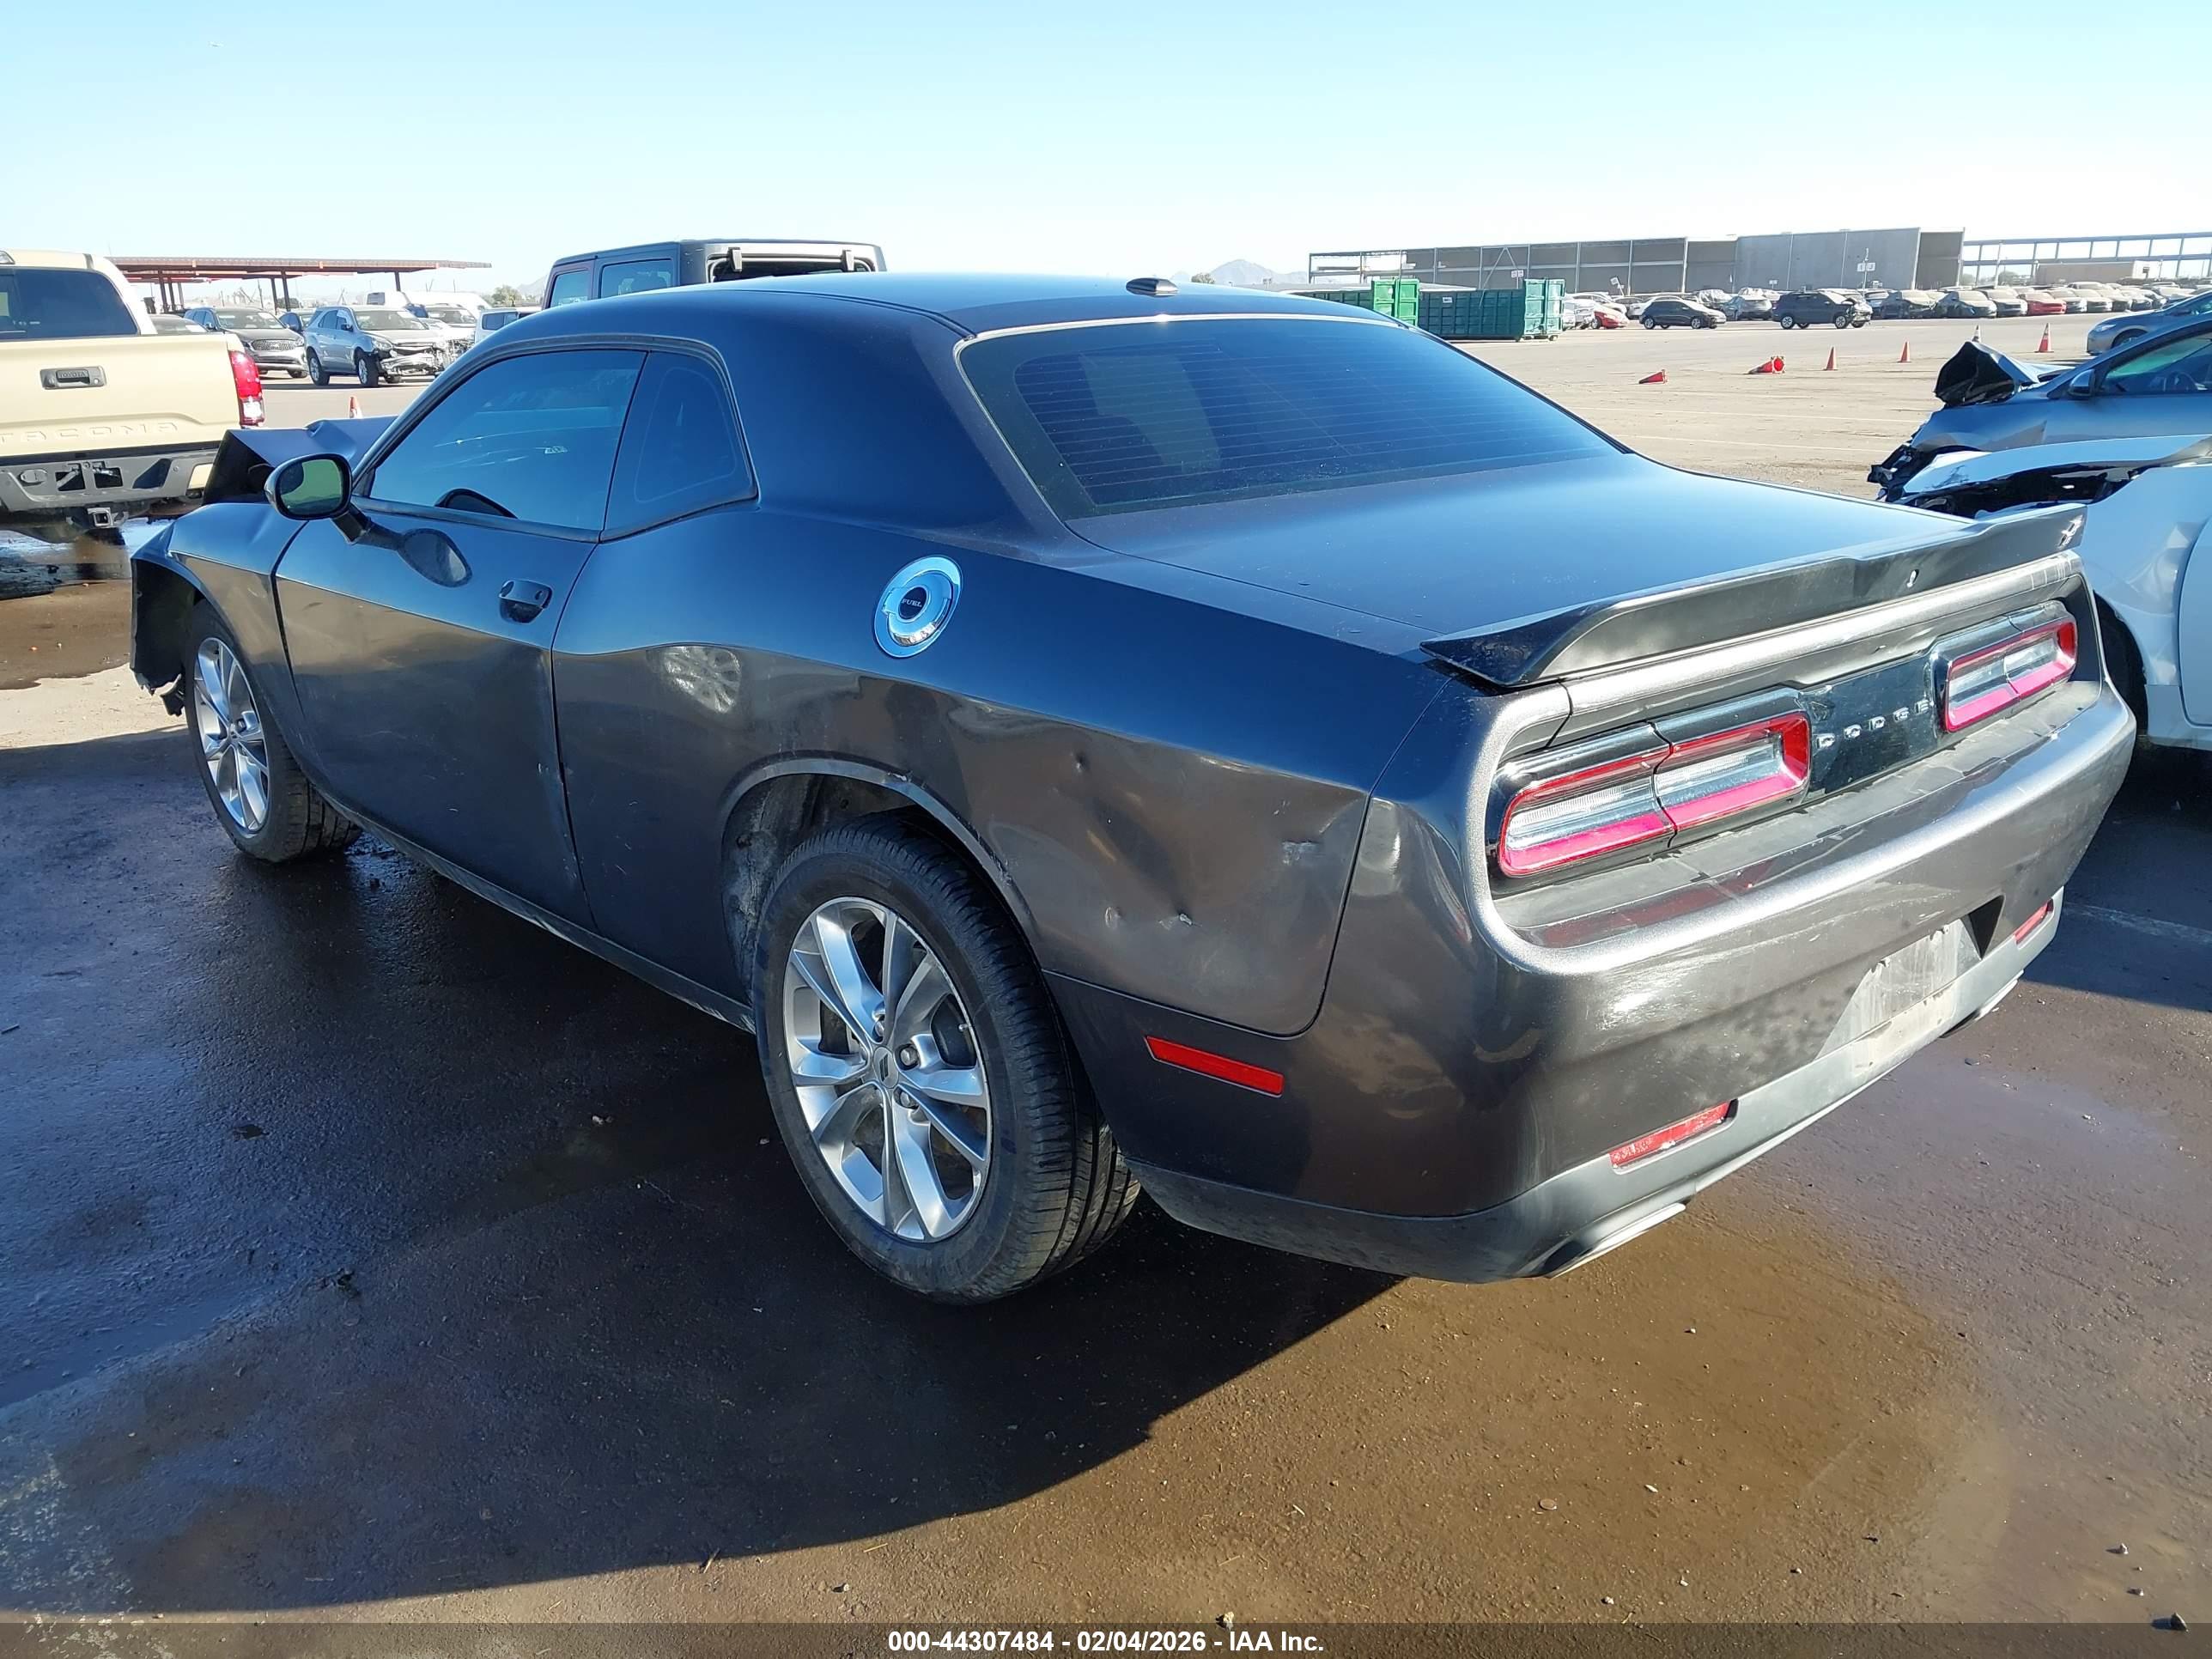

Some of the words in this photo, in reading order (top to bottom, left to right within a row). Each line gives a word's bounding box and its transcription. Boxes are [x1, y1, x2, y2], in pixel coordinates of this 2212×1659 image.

[1, 422, 178, 442] TACOMA
[902, 599, 922, 607] FUEL
[1816, 699, 1932, 749] DODGE
